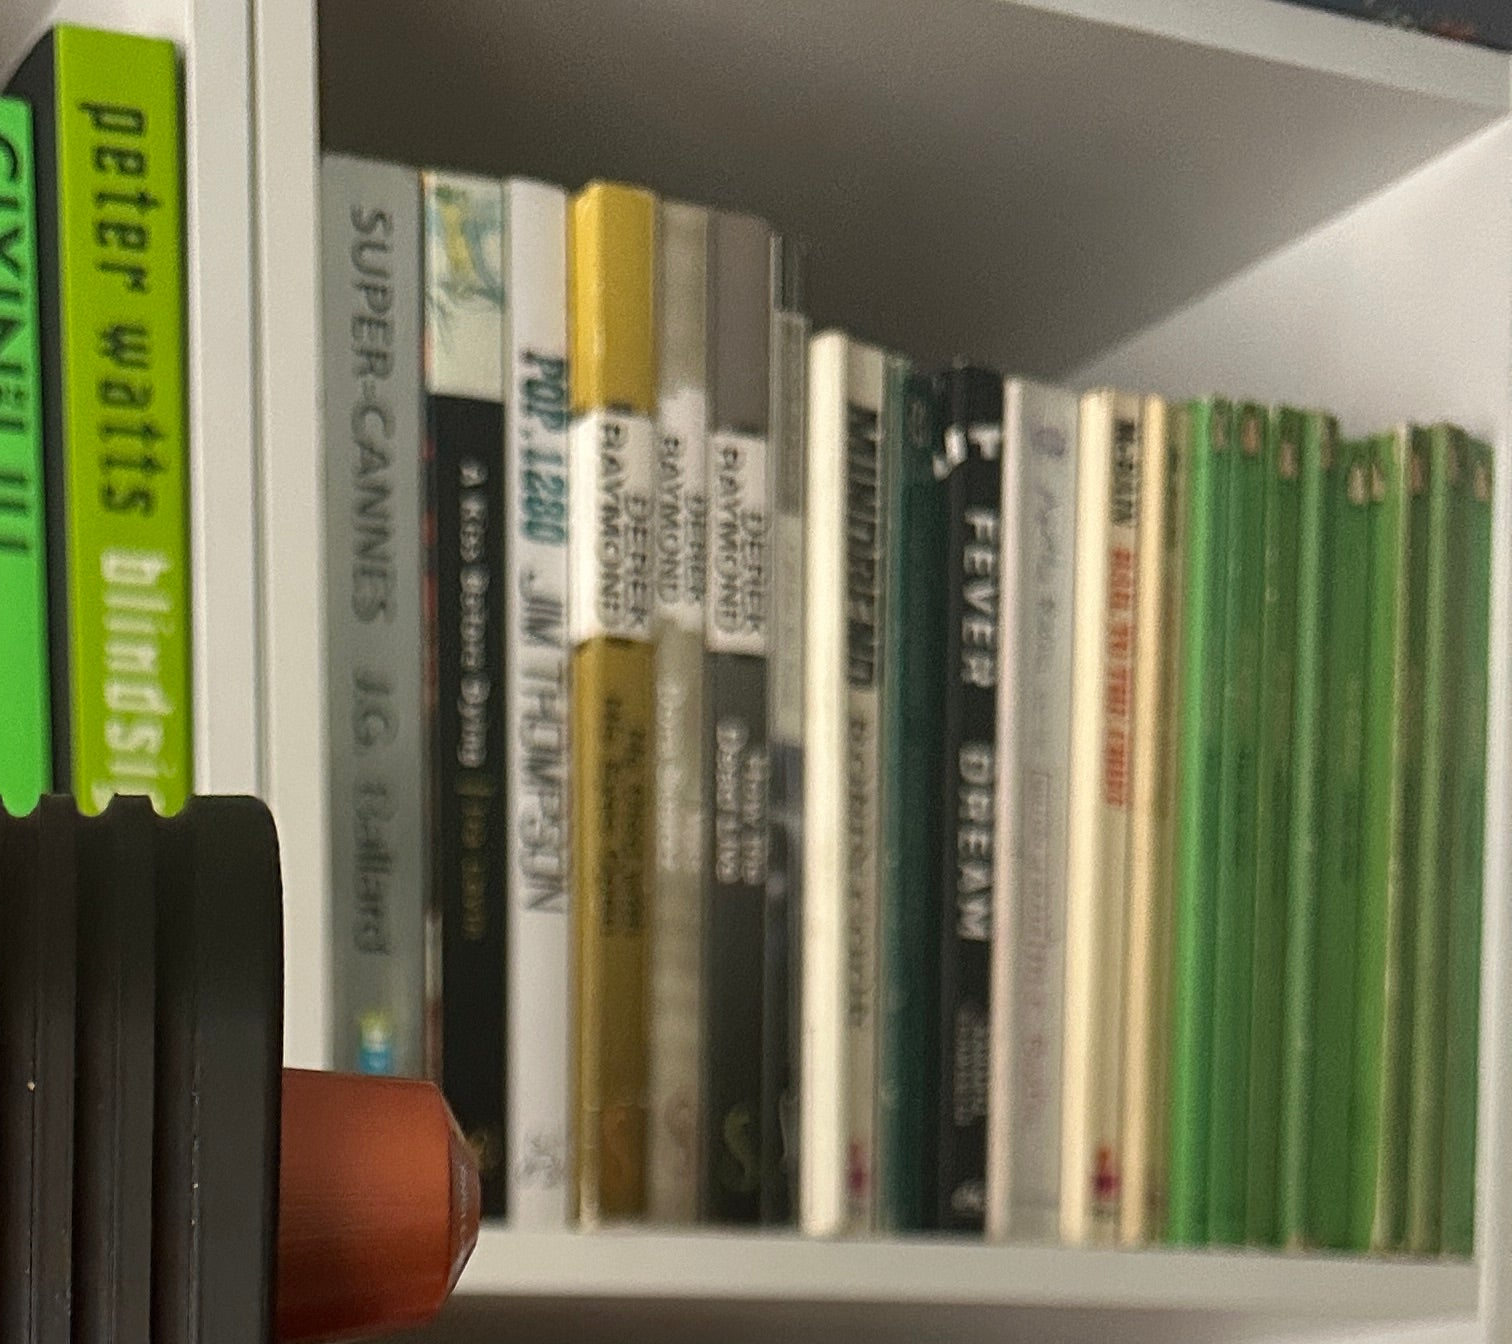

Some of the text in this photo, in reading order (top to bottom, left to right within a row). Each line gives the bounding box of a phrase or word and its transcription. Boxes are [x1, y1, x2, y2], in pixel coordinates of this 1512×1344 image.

[79, 97, 174, 520] peter watts
[349, 205, 395, 625] SUPER-CANNES
[96, 547, 174, 817] blindsi
[599, 424, 628, 632] RAYMOND
[714, 446, 743, 634] RAYMOND
[956, 505, 998, 945] FEVER DREAM
